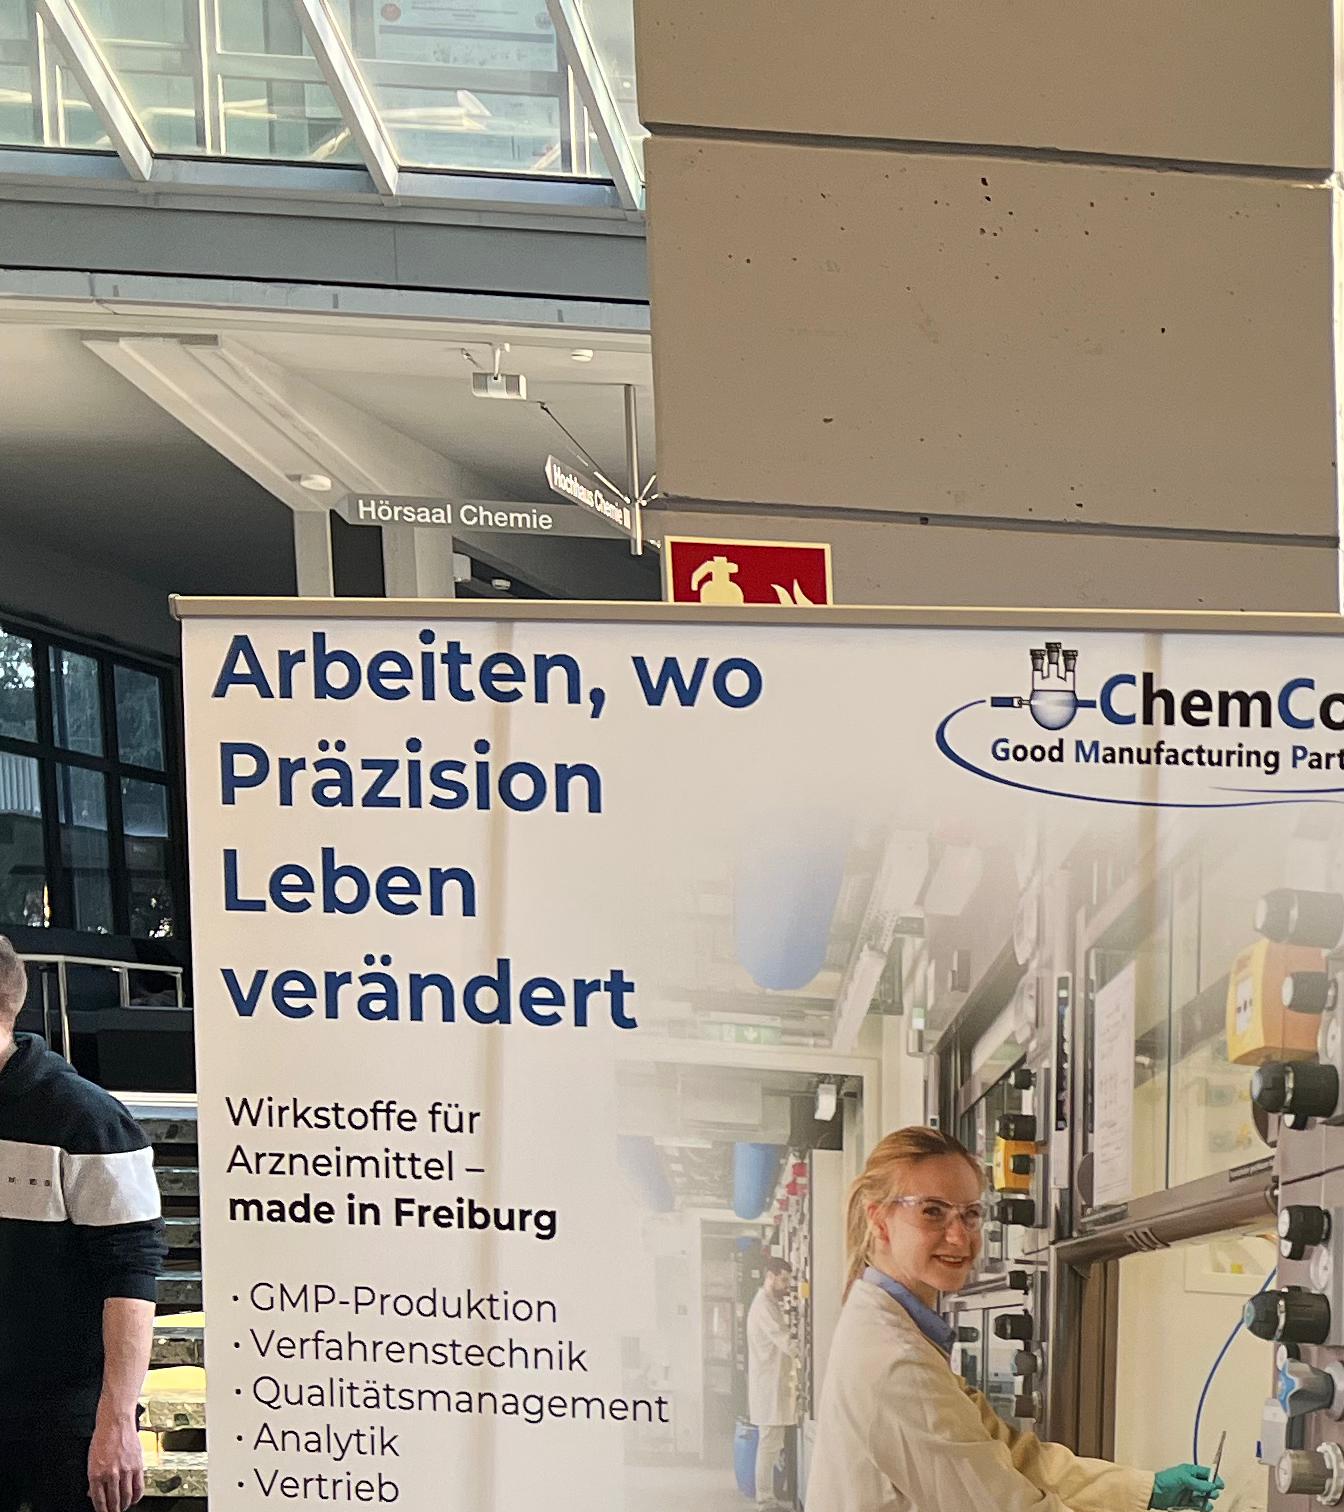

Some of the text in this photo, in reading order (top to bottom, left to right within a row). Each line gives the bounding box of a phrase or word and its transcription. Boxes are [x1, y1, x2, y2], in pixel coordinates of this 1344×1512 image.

[358, 499, 554, 530] Hörsaal Chemie
[552, 463, 595, 508] Hochhaus
[594, 489, 624, 526] Chemie
[212, 629, 764, 719] Arbeiten, wo
[219, 737, 603, 814] Präzision
[991, 738, 1064, 763] Good
[1075, 738, 1280, 775] Manufacturing
[222, 847, 477, 917] Leben
[220, 953, 638, 1030] verändert
[225, 1096, 482, 1135] Wirkstoffe für
[226, 1144, 454, 1181] Arzneimittel
[229, 1194, 558, 1241] made in Freiburg
[249, 1281, 558, 1324] GMP-Produktion
[249, 1327, 589, 1372] Verfahrenstechnik
[252, 1375, 670, 1424] Qualitätsmanagement
[253, 1422, 401, 1461] Analytik
[253, 1468, 400, 1503] Vertrieb
